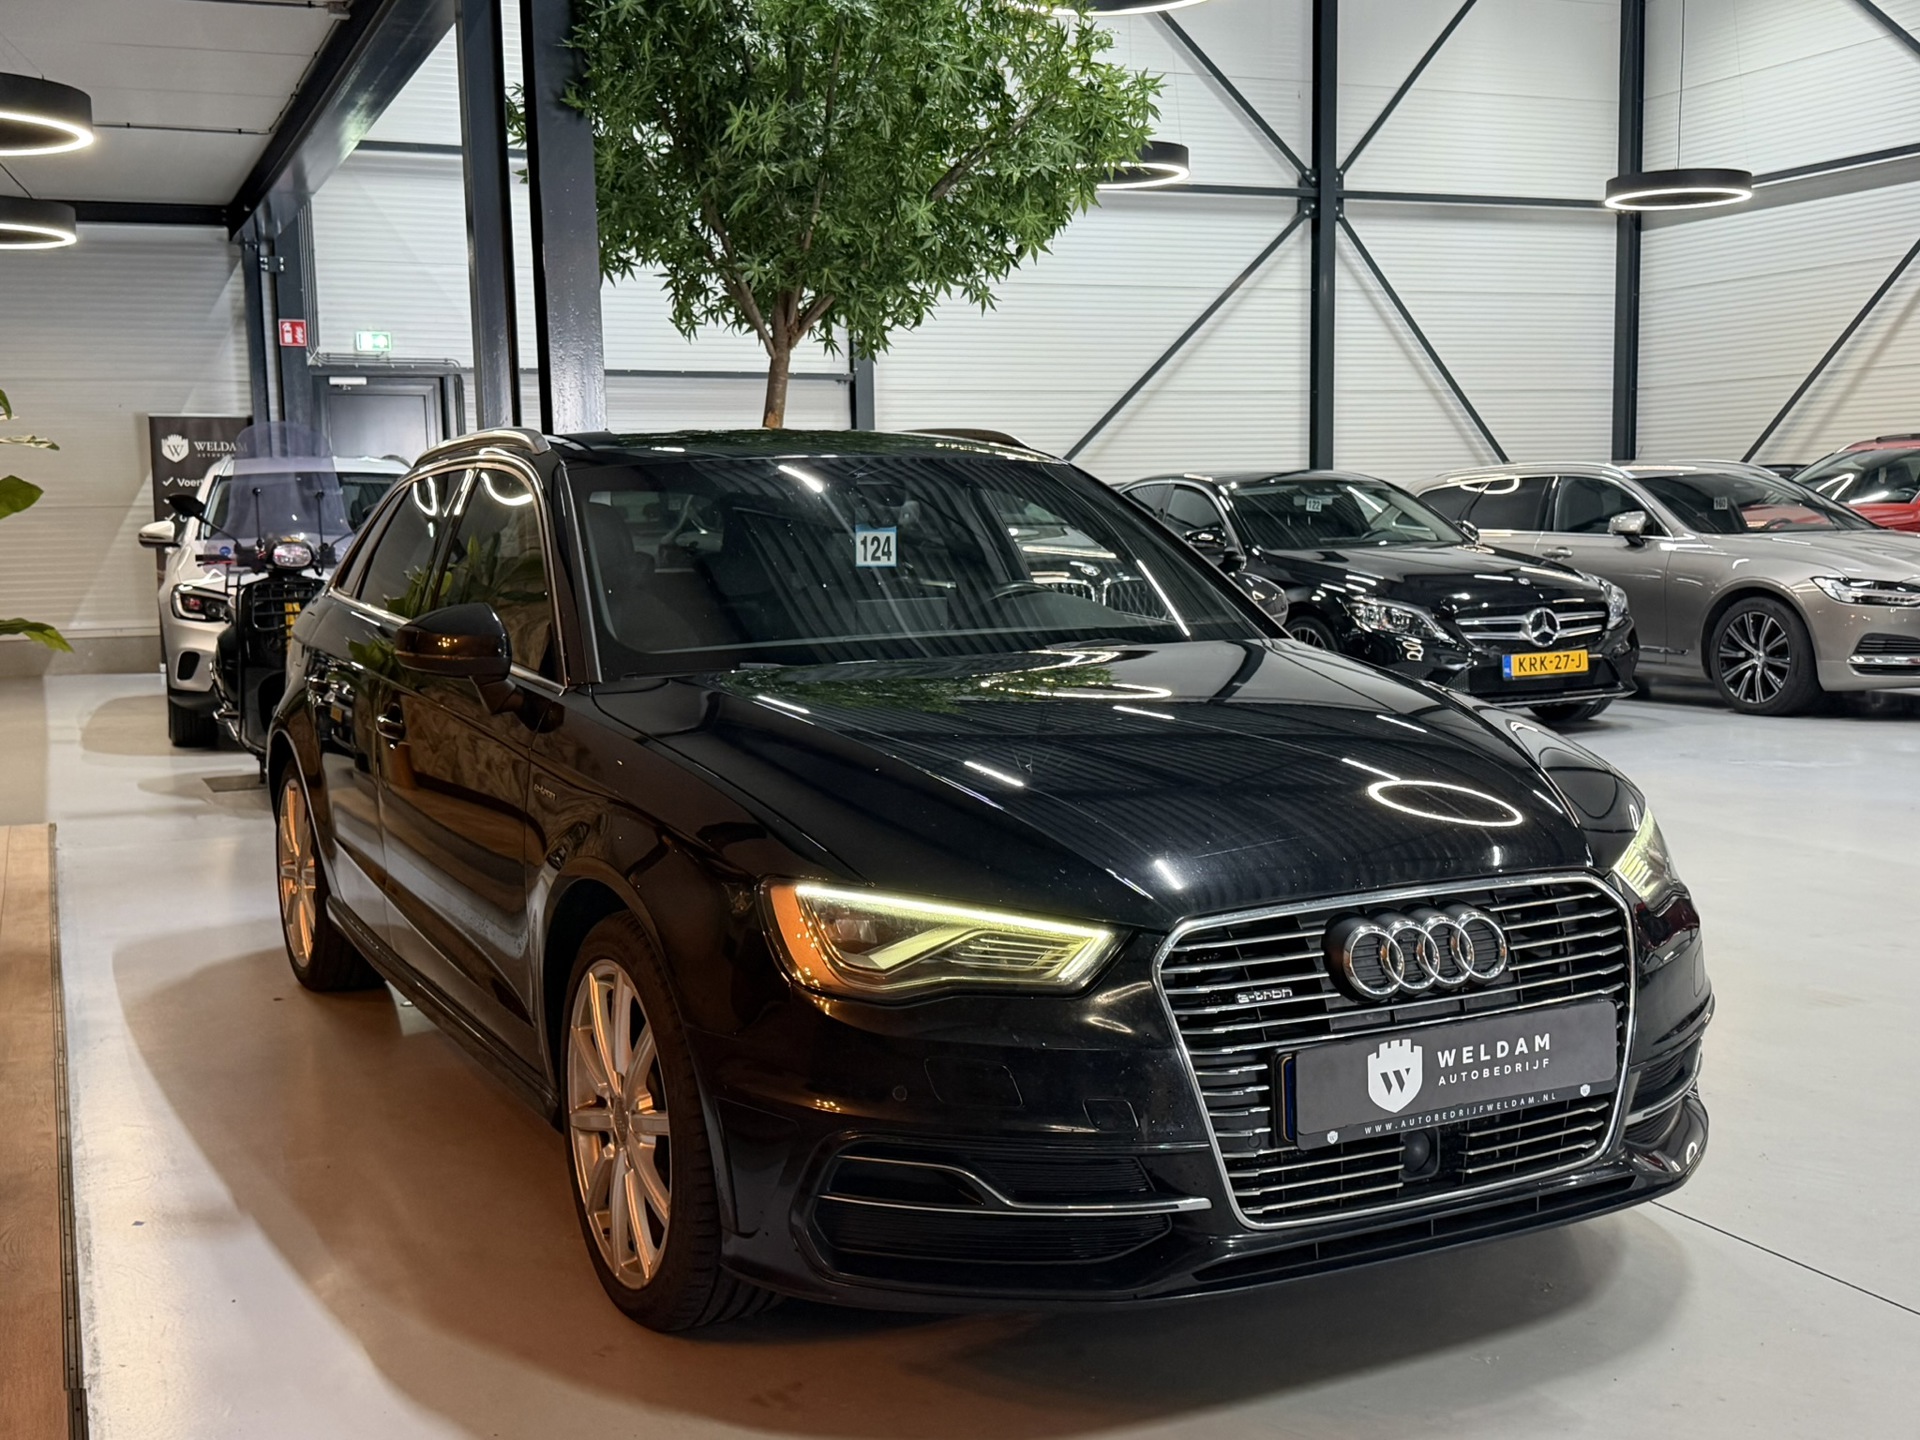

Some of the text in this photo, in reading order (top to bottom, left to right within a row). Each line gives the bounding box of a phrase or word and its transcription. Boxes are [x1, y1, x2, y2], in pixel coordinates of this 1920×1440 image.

[1308, 500, 1320, 510] 122
[860, 535, 893, 562] 124
[1518, 652, 1582, 673] KRK-27-J
[1437, 1033, 1551, 1068] WELDAM
[1380, 1067, 1411, 1096] W
[1438, 1057, 1551, 1087] AUTOBEDRIJF
[1364, 1092, 1557, 1136] WWW.AUTOBEDRIJFWELDAM.NL
